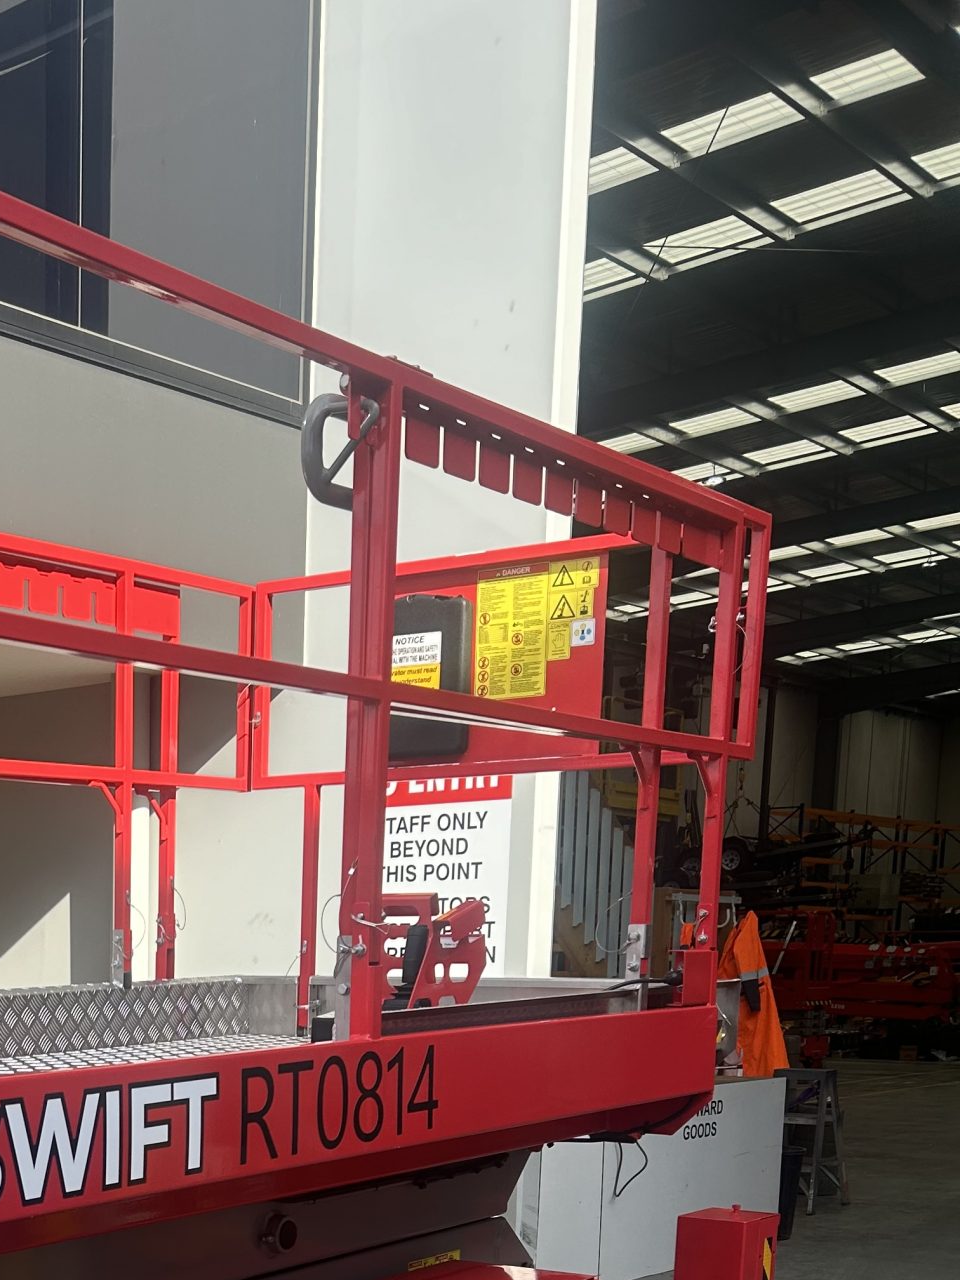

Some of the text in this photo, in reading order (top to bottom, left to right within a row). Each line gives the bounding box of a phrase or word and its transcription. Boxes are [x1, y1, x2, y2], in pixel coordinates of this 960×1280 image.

[502, 567, 531, 576] DANGER
[395, 636, 425, 645] NOTICE
[386, 811, 488, 834] TAFF ONLY
[390, 838, 469, 858] BEYOND
[423, 862, 483, 881] POINT
[240, 1045, 439, 1166] RT0814
[683, 1122, 717, 1140] GOODS
